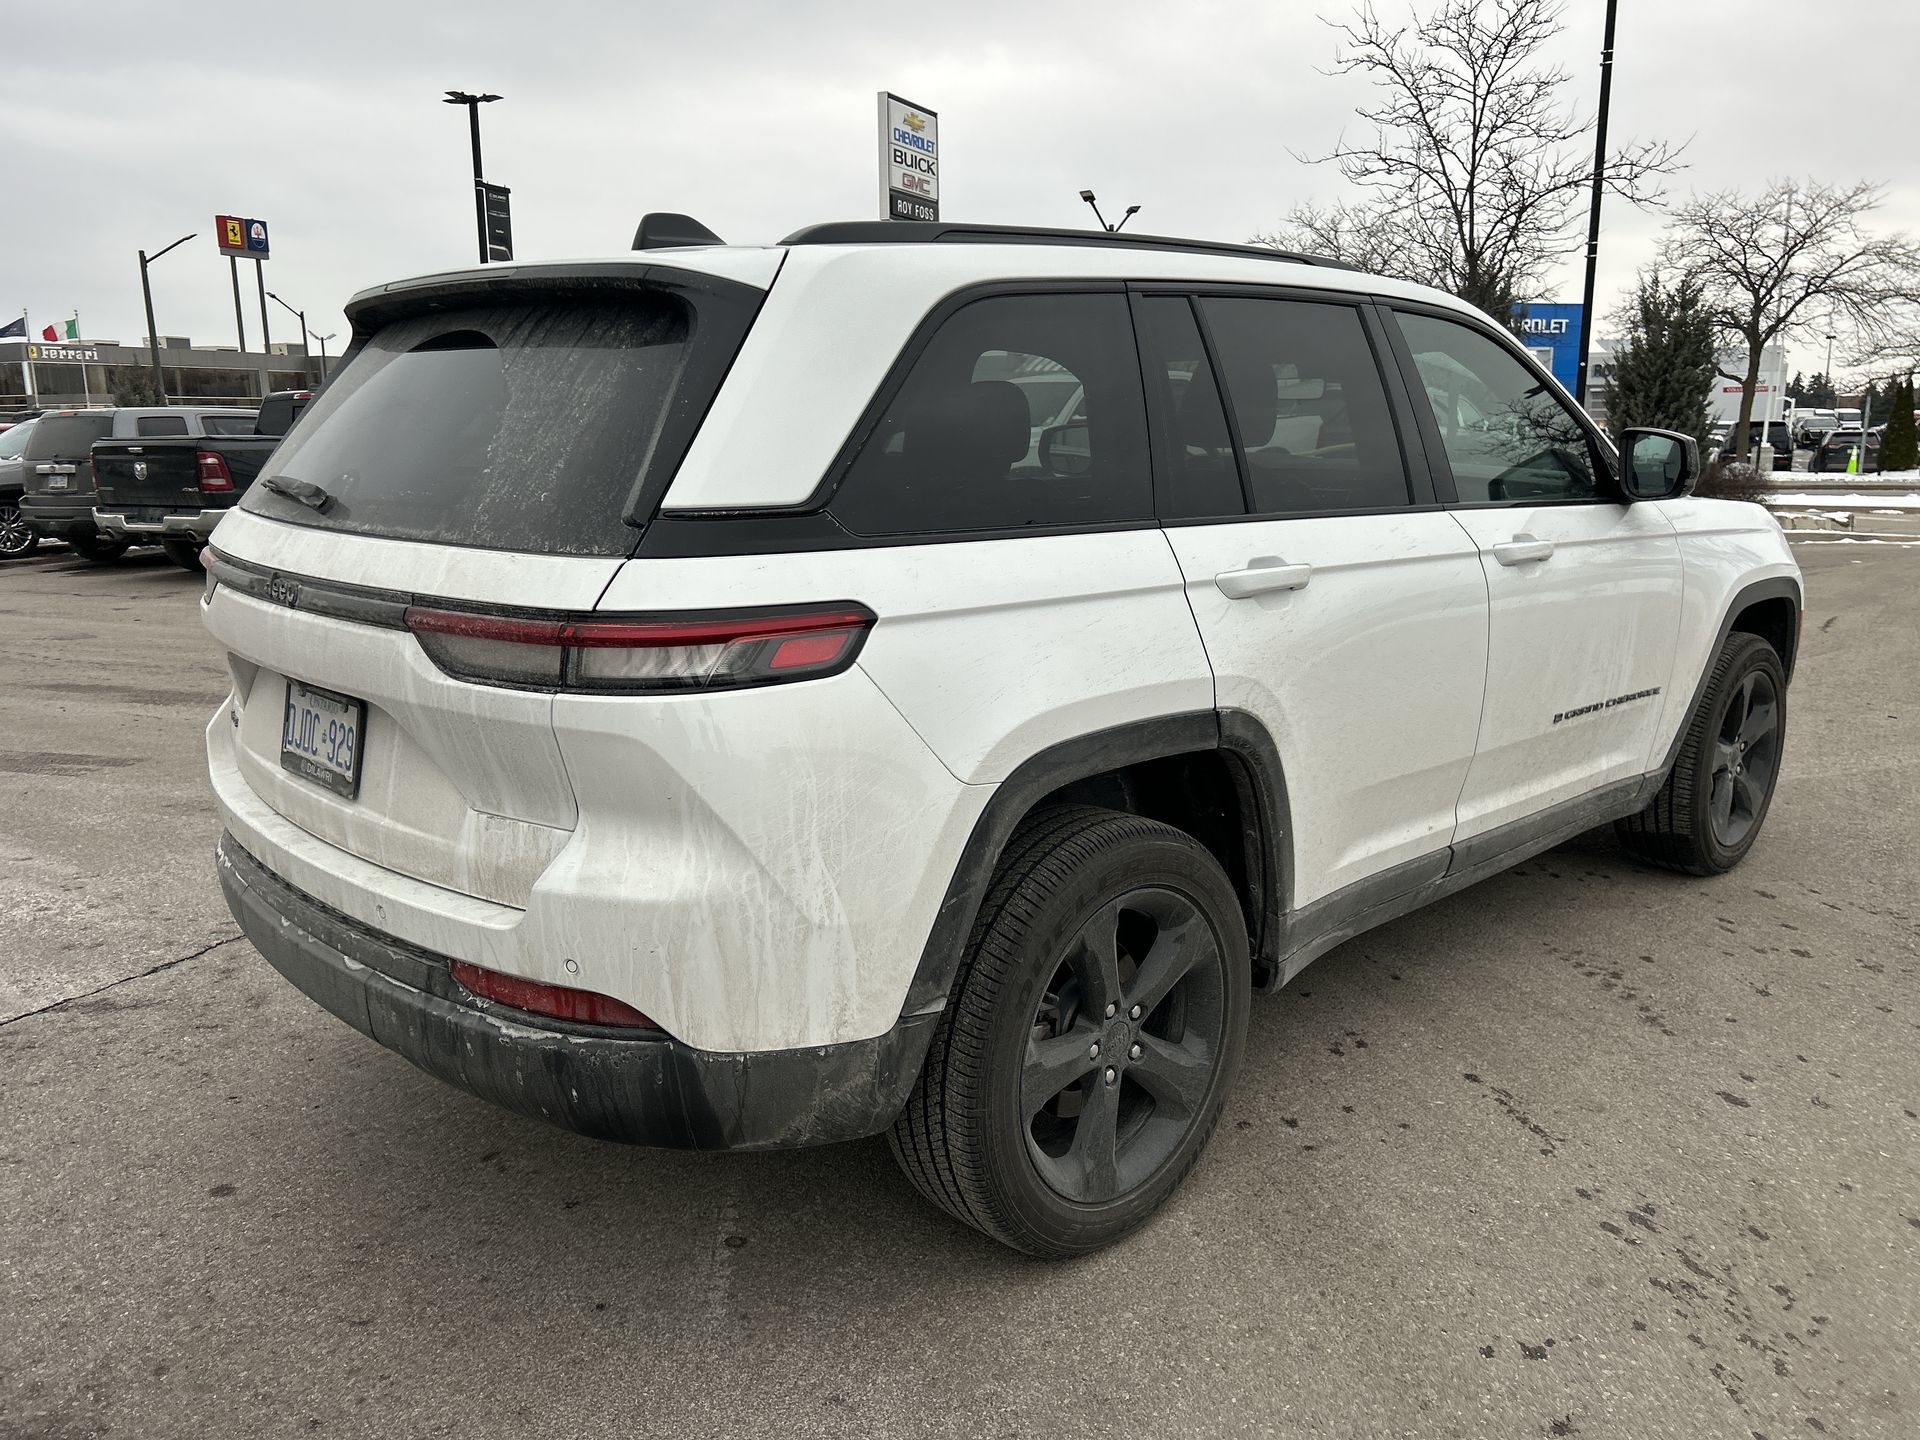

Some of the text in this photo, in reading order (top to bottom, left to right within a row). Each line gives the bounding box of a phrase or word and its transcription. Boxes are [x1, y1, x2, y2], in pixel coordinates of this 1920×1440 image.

[893, 127, 935, 155] CHEVROLET
[893, 148, 936, 176] BUICK
[902, 173, 930, 195] GMC
[897, 199, 934, 221] ROY FOSS
[40, 345, 99, 361] Ferrari
[327, 719, 355, 771] 929
